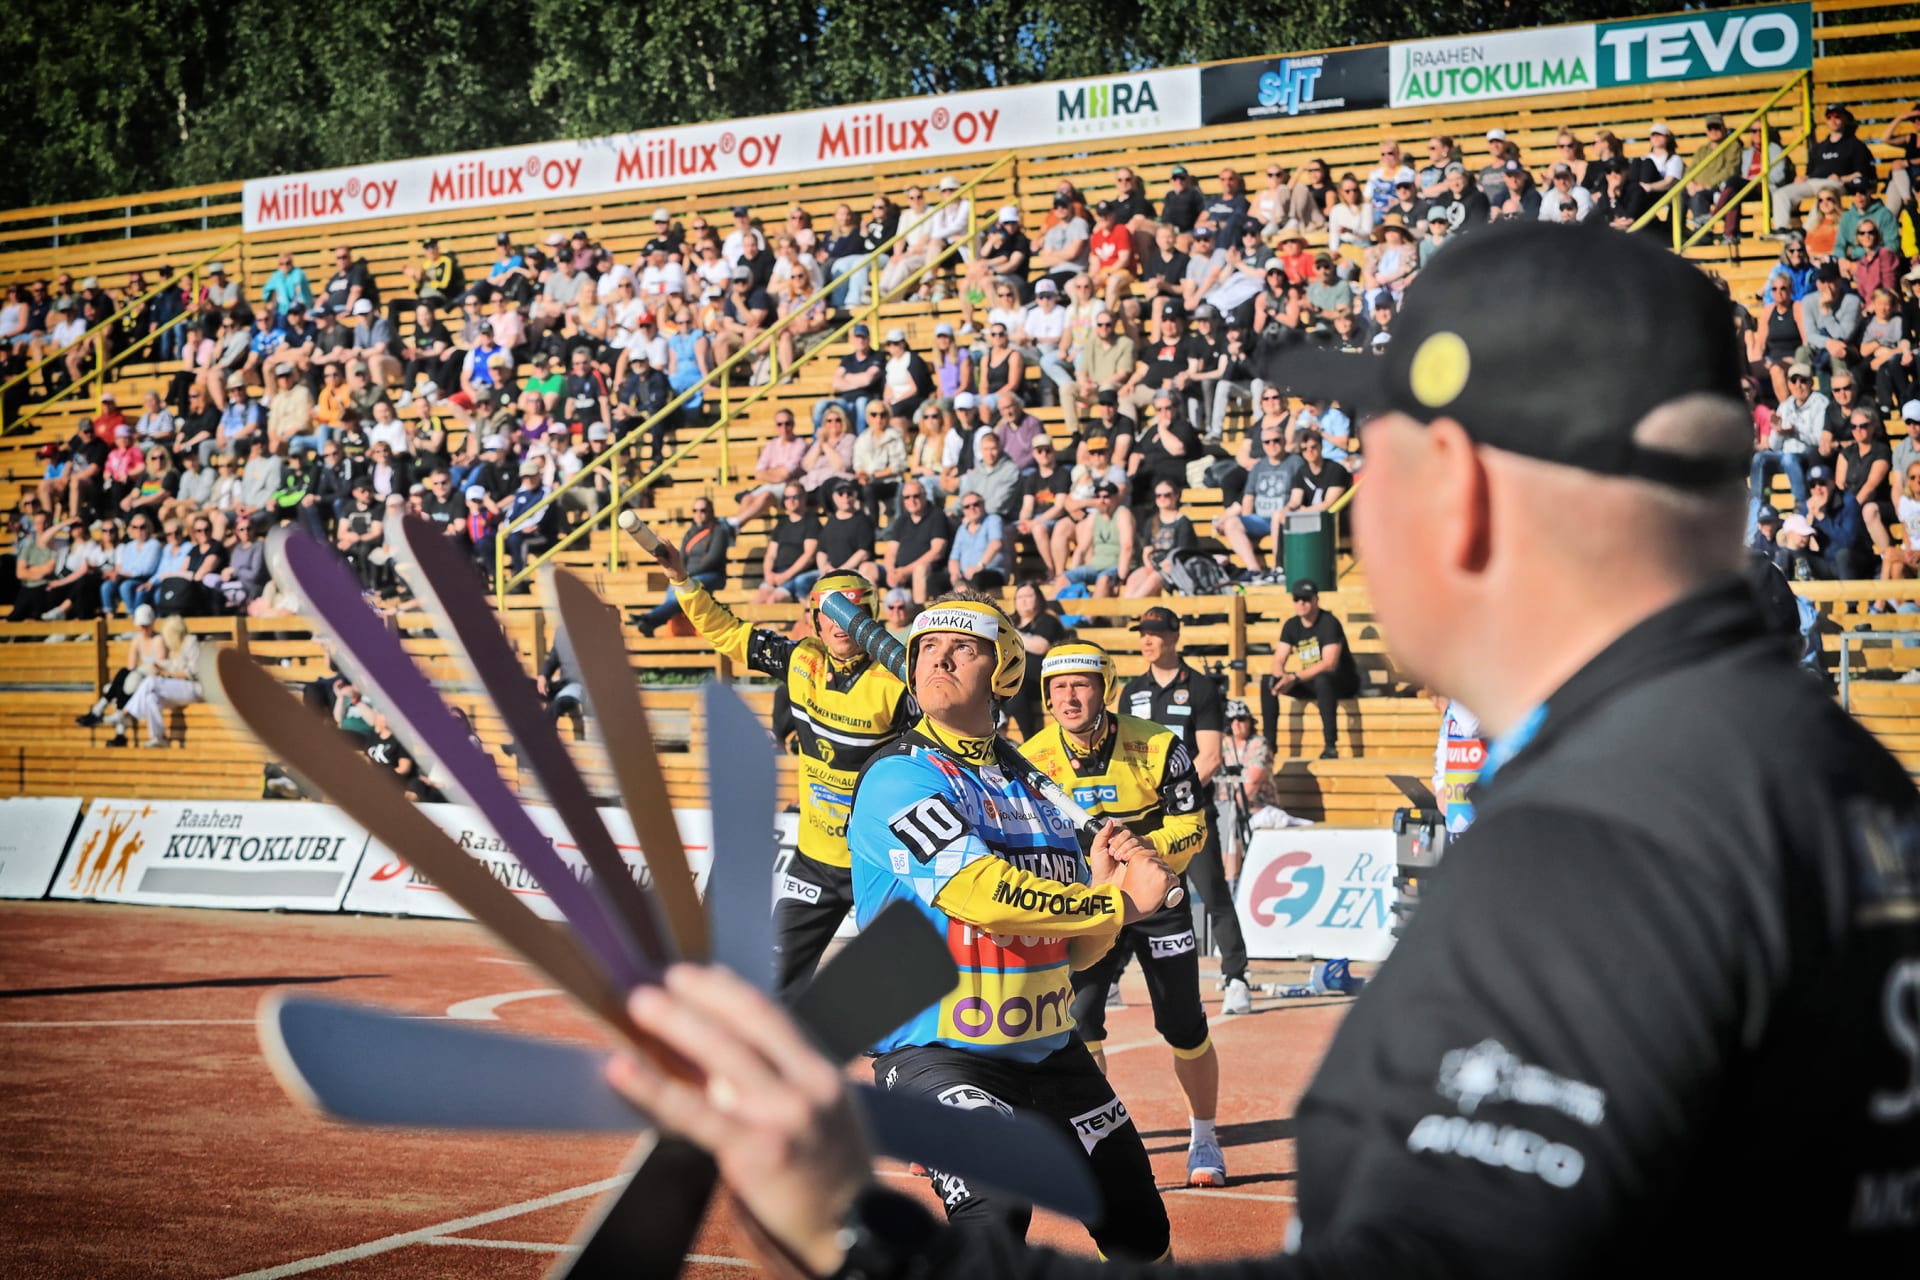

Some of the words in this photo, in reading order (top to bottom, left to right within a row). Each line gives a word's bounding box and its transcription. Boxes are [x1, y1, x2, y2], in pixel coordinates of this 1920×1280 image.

[1413, 46, 1484, 67] RAAHEN
[1600, 13, 1801, 81] TEVO
[1257, 58, 1322, 116] SHT
[1406, 56, 1589, 100] AUTOKULMA
[928, 615, 974, 632] MAKIA
[1073, 788, 1116, 803] TEVO
[176, 809, 244, 829] Raahen
[893, 797, 963, 857] 10
[163, 834, 346, 862] KUNTOKLUBI
[998, 882, 1116, 916] MOTOCAFE
[1150, 933, 1194, 951] TEVO
[1076, 1101, 1129, 1135] TEVO
